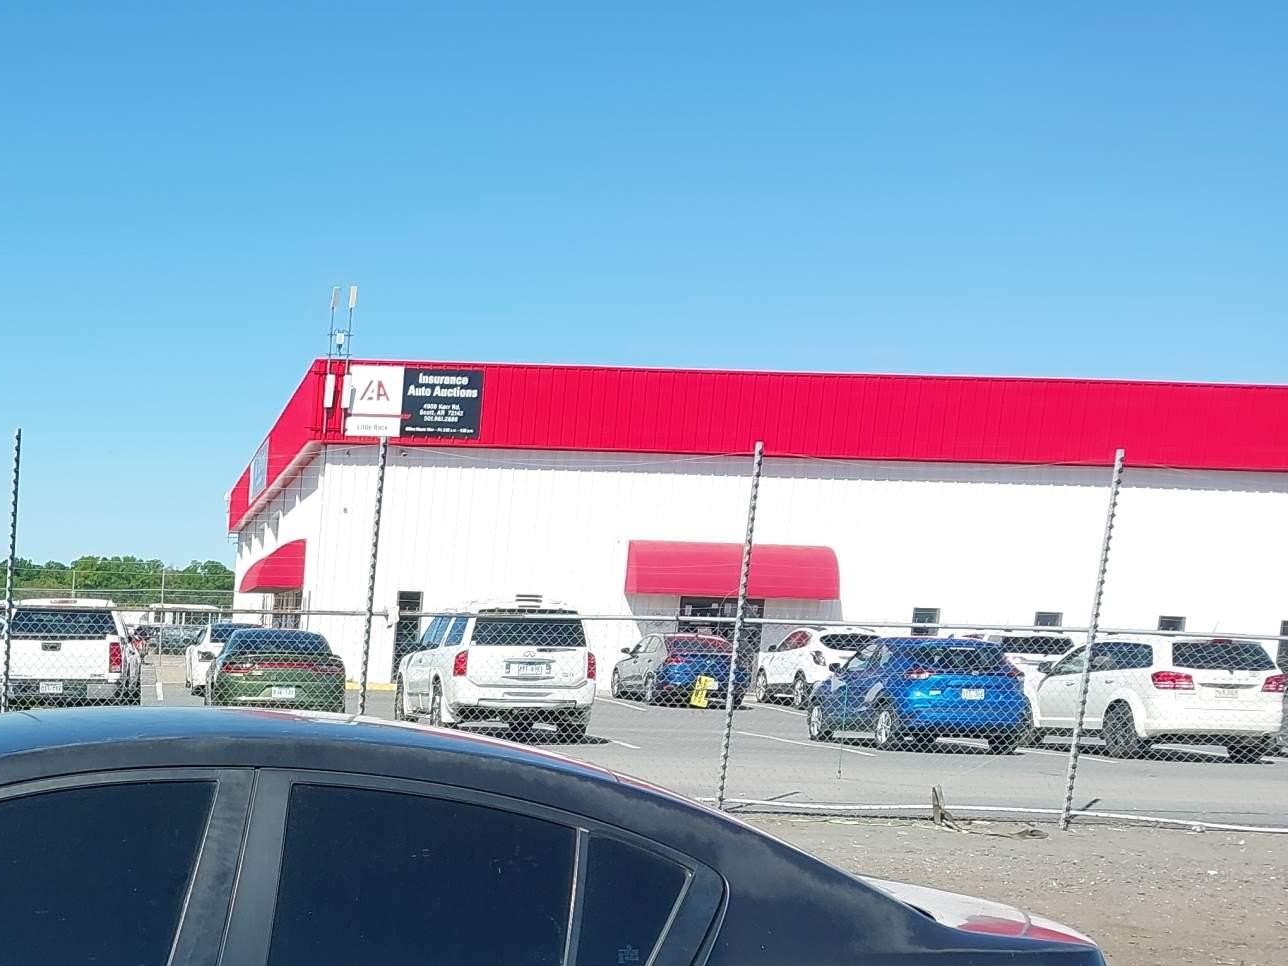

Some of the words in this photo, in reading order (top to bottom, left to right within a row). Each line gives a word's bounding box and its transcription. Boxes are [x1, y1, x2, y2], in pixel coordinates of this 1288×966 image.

[418, 372, 469, 386] Insurance
[407, 384, 432, 397] Auto
[432, 385, 478, 398] Auctions
